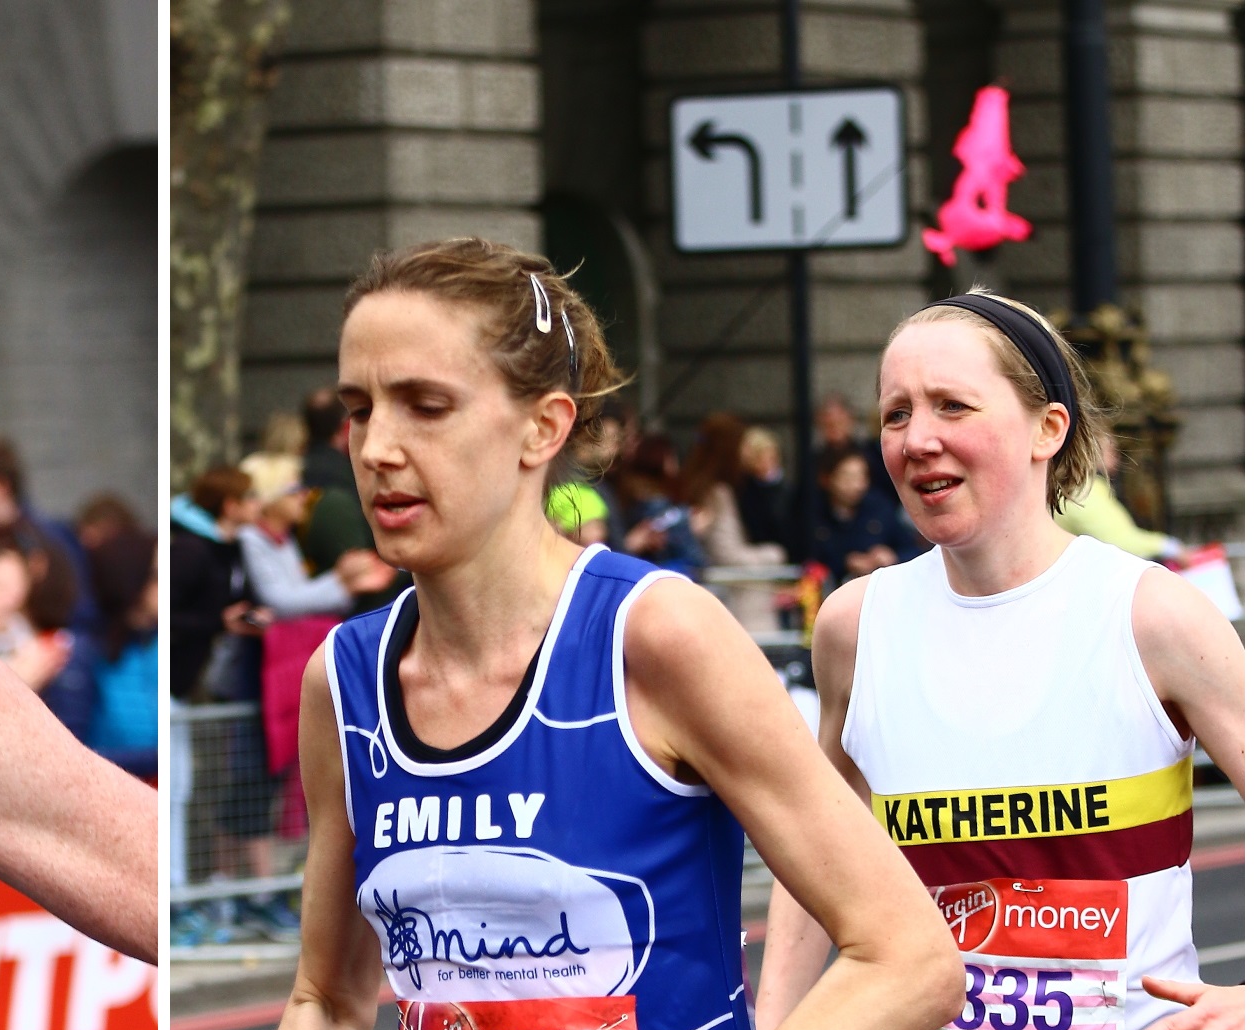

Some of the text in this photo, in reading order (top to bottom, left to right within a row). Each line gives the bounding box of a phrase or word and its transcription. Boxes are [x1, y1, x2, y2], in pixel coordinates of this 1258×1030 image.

[373, 793, 545, 848] EMILY
[885, 785, 1109, 841] KATHERINE
[432, 912, 590, 962] mind
[1004, 904, 1120, 937] money
[438, 964, 586, 981] for better mental health
